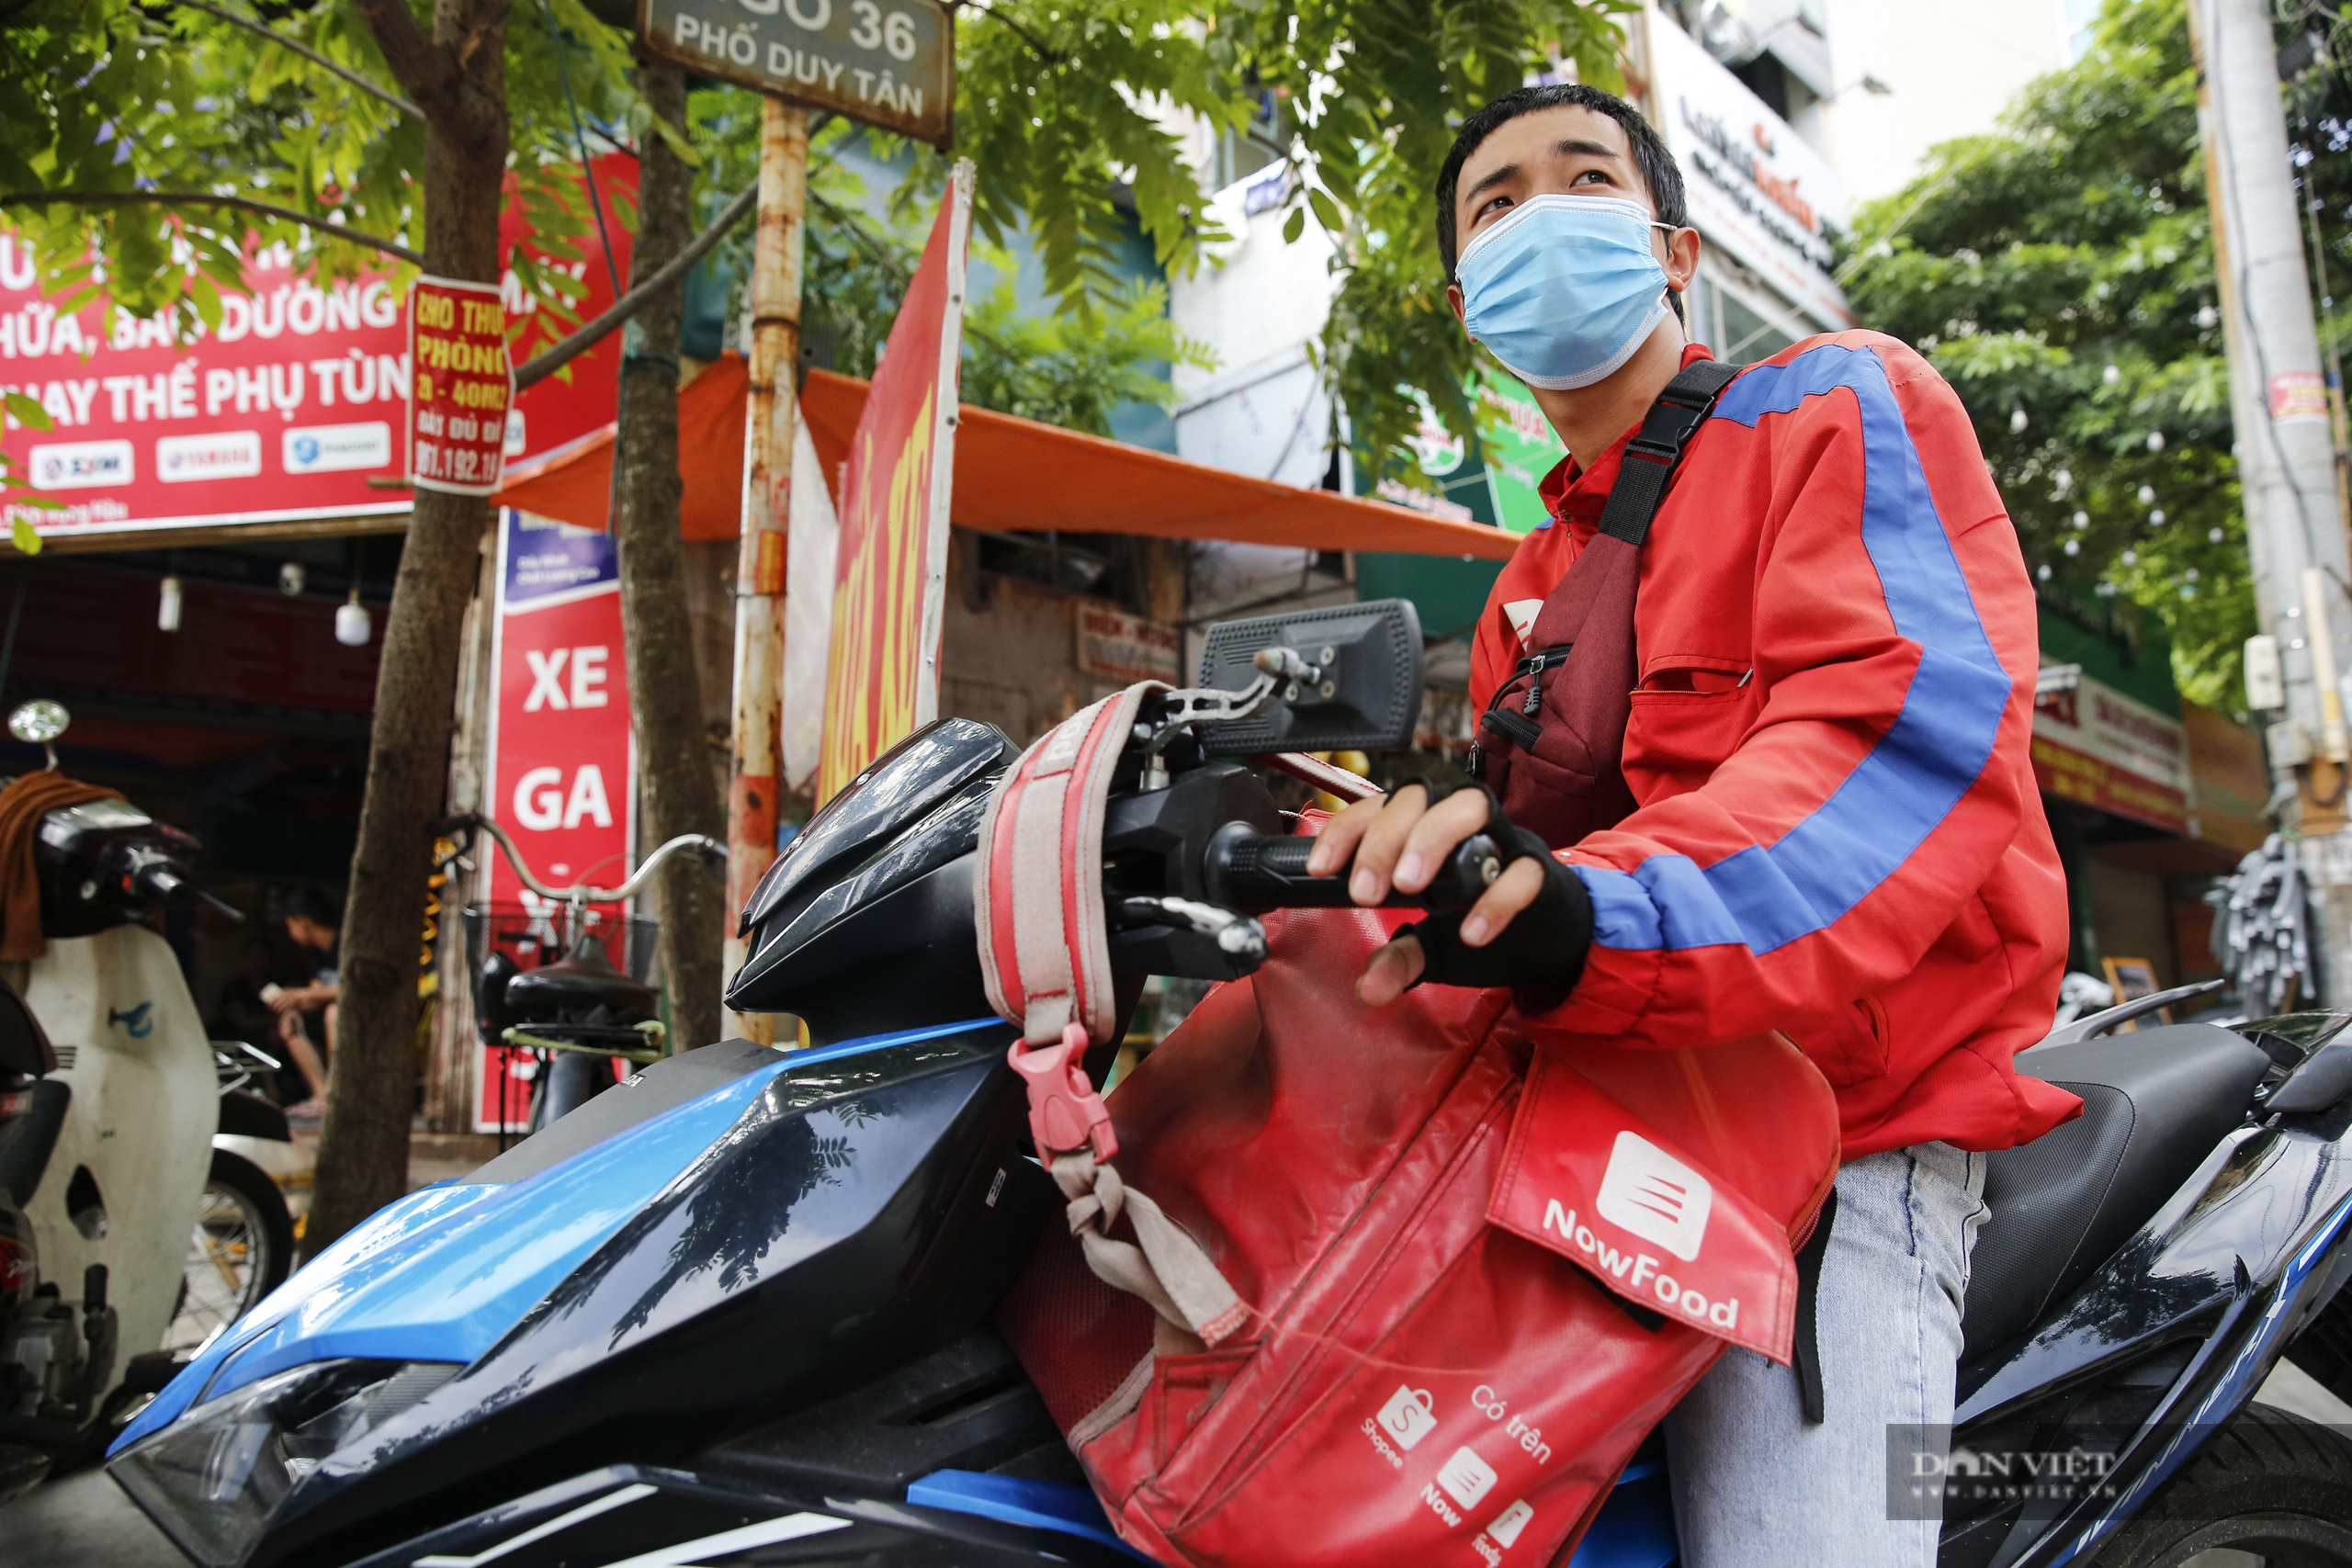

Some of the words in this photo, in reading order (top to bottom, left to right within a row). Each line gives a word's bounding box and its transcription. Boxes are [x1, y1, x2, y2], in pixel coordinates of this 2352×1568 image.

[673, 12, 758, 65] PHỐ
[766, 41, 844, 91] DUY
[853, 69, 922, 118] TÂN
[851, 0, 918, 62] 36
[103, 356, 199, 423] THẾ
[205, 362, 306, 423] PHỤ
[523, 645, 609, 713] XE
[513, 763, 613, 831] GA
[1543, 1198, 1739, 1330] NowFood
[1361, 1417, 1403, 1469] Shopee
[1471, 1384, 1508, 1421] Có
[1505, 1414, 1552, 1464] trên
[1419, 1483, 1462, 1528] Now
